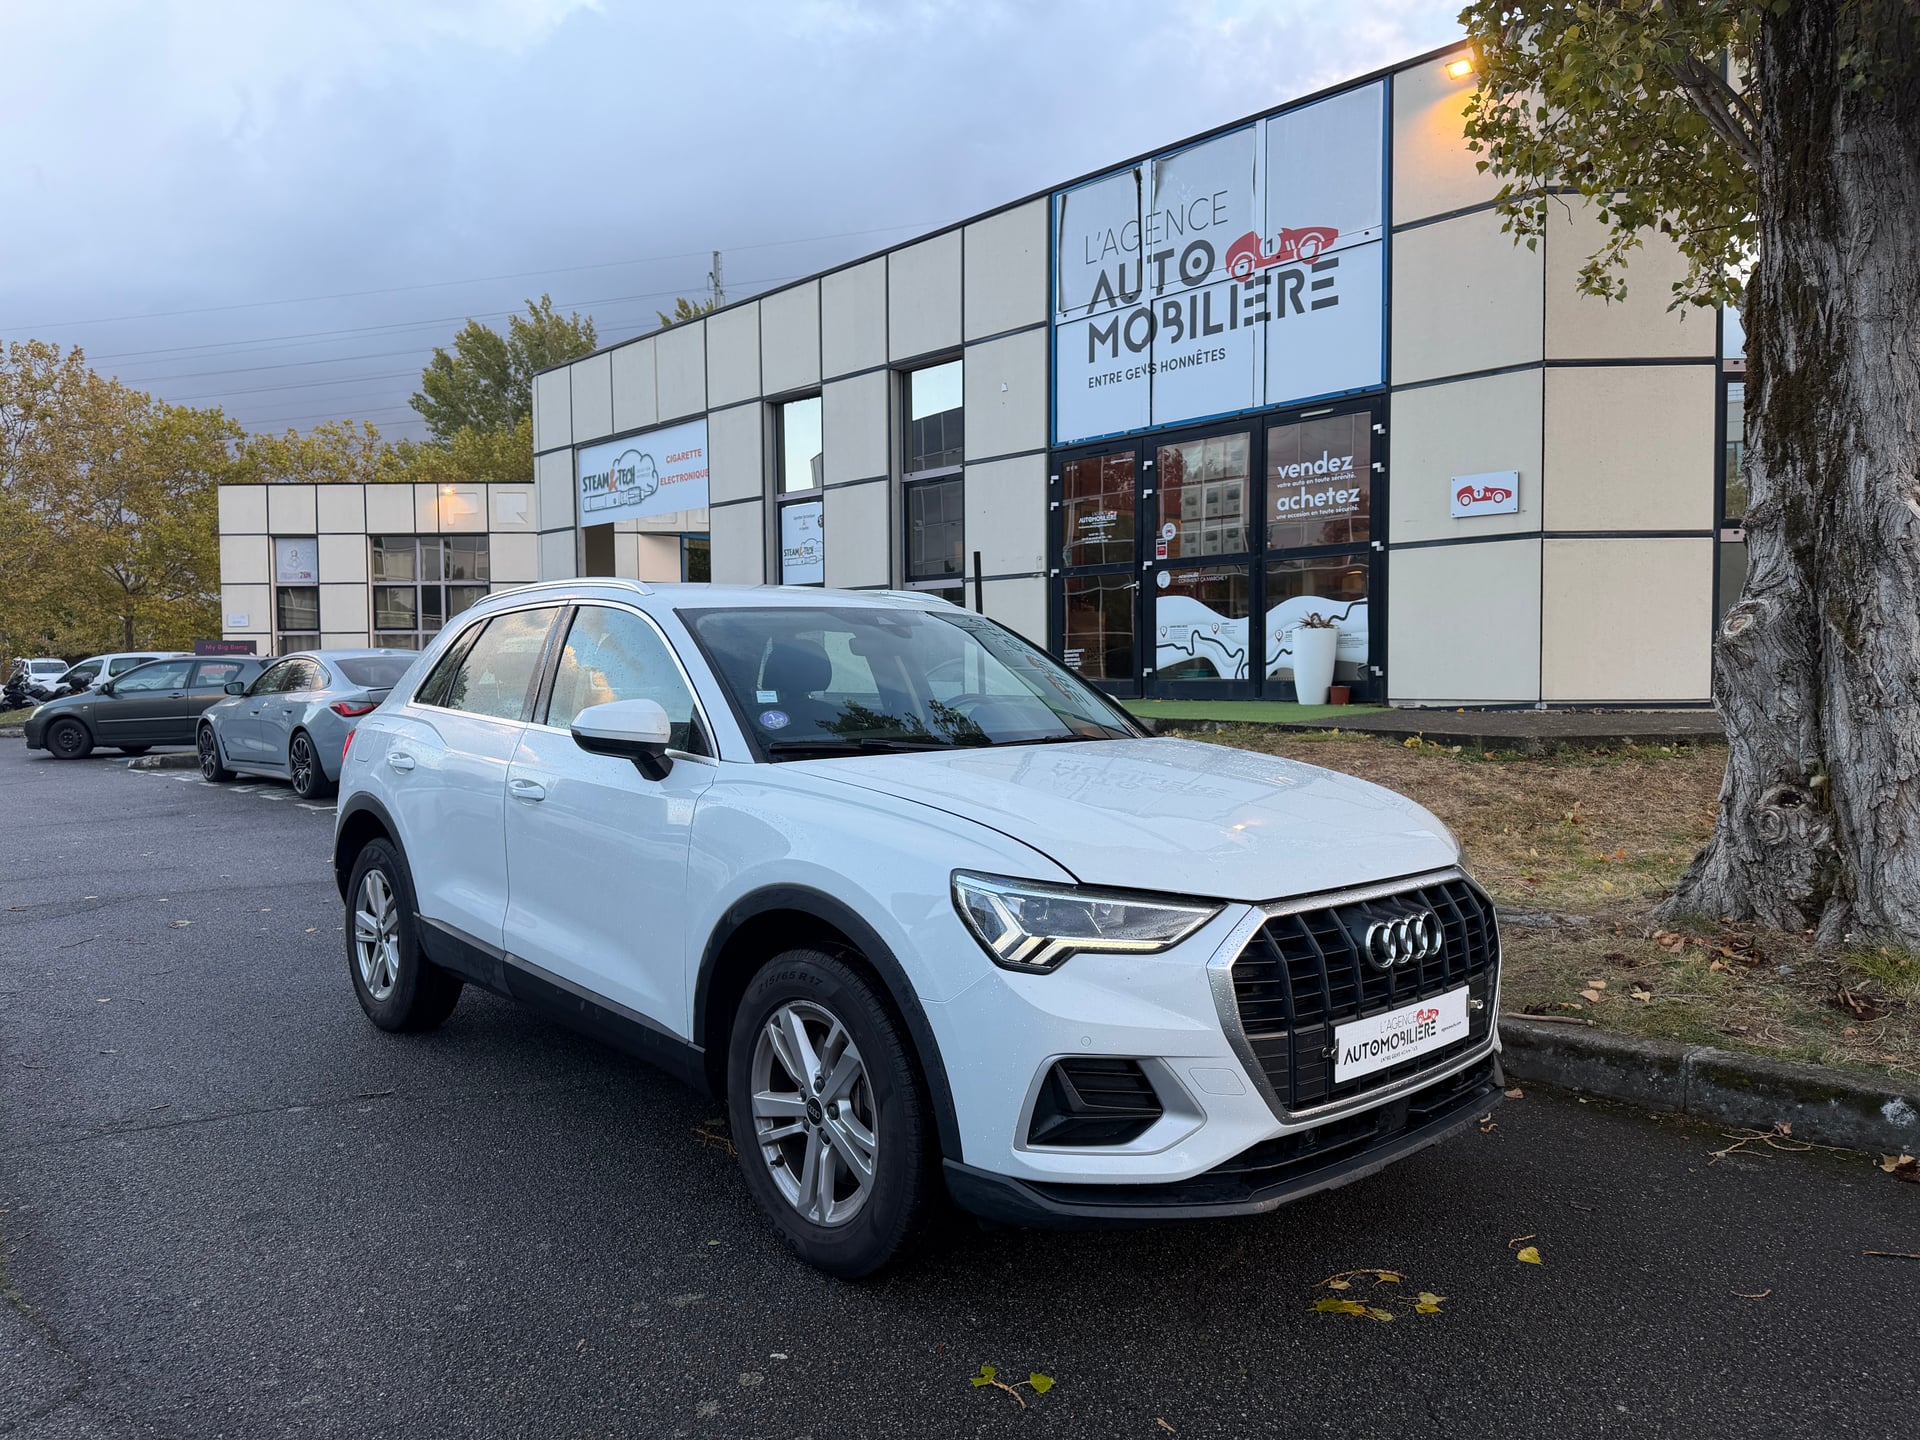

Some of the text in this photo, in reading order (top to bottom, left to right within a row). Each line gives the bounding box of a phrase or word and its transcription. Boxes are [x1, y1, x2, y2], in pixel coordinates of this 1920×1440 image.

[1085, 190, 1229, 265] L'AGENCE
[1086, 239, 1216, 315] AUTO
[1088, 347, 1227, 389] ENTRE GENS HONNÊTES
[665, 448, 703, 464] CIGARETTE
[1277, 450, 1354, 479] vendez
[659, 468, 709, 486] ELECTRONIQUE
[1276, 486, 1361, 511] achetez
[1287, 510, 1311, 519] occasion
